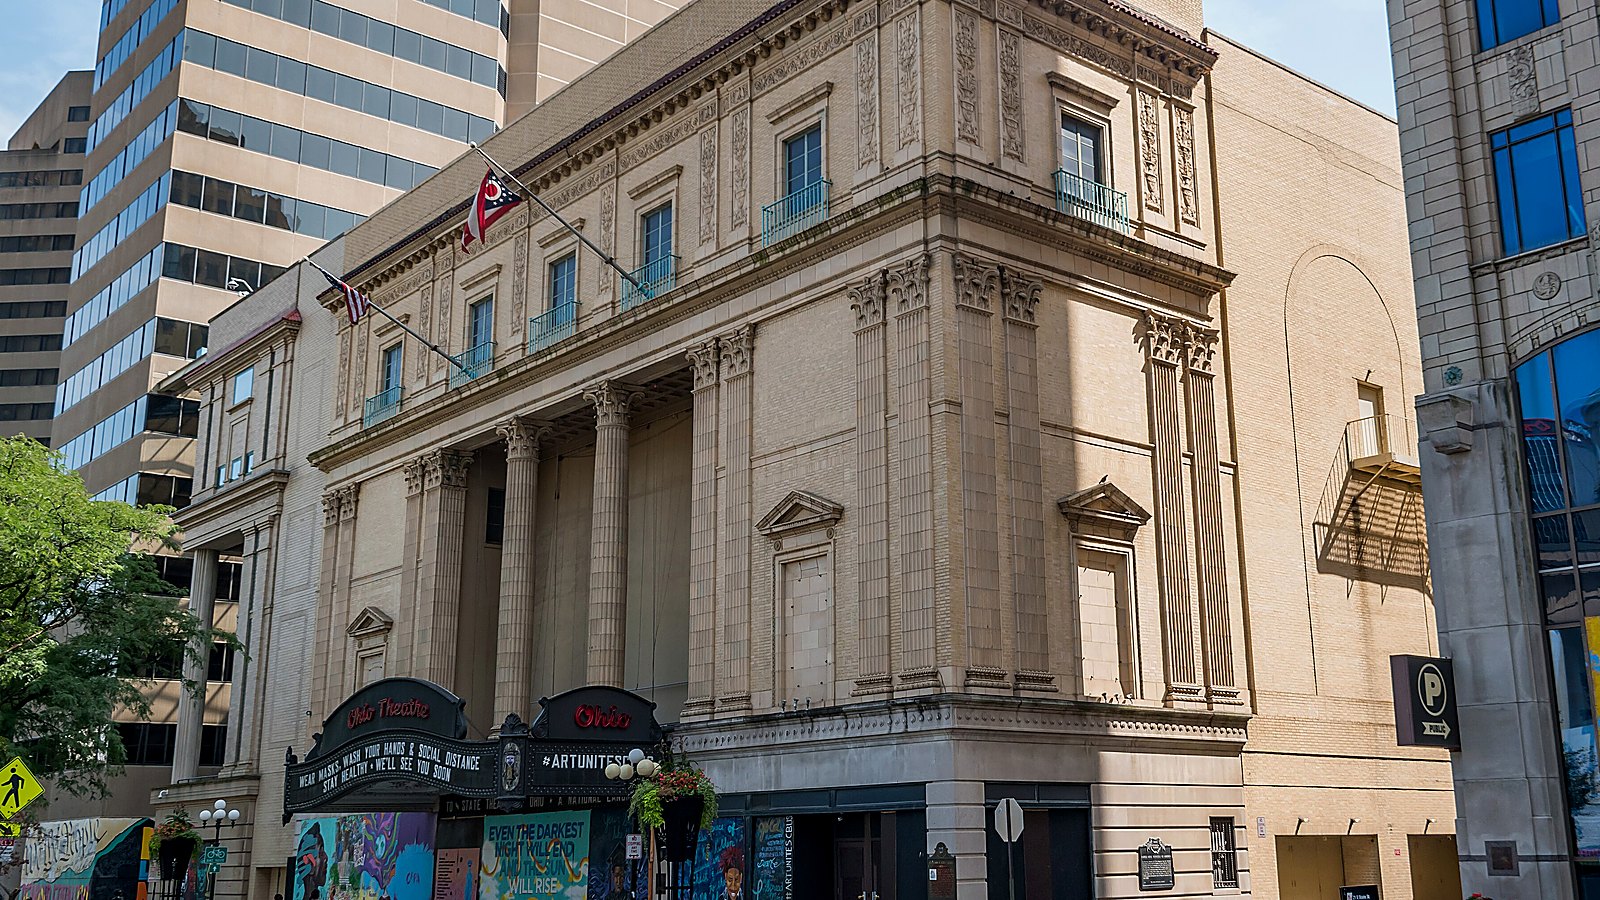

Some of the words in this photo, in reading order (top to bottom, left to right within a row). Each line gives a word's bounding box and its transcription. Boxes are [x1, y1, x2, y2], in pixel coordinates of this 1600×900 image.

[1424, 672, 1442, 706] P
[347, 703, 375, 729] Ohio
[378, 697, 430, 719] Theatre
[575, 704, 632, 729] Ohio
[1429, 724, 1447, 734] PUBLIC
[300, 773, 316, 788] WEAR
[343, 749, 361, 769] WASH
[365, 743, 380, 759] YOUR
[384, 742, 405, 756] HANDS
[409, 743, 414, 756] &
[419, 744, 440, 763] SOCIAL
[446, 751, 480, 771] DISTANCE
[323, 775, 339, 793] STAY
[376, 757, 396, 771] WE'LL
[401, 757, 413, 771] SEE
[418, 758, 430, 775] YOU
[433, 764, 451, 782] SOON
[461, 798, 481, 812] STATE
[489, 826, 514, 841] EVEN
[516, 824, 535, 840] THE
[537, 822, 584, 839] DARKEST
[495, 841, 524, 857] NIGHT
[527, 841, 550, 857] WILL
[509, 878, 533, 894] WILL
[535, 878, 557, 894] RISE
